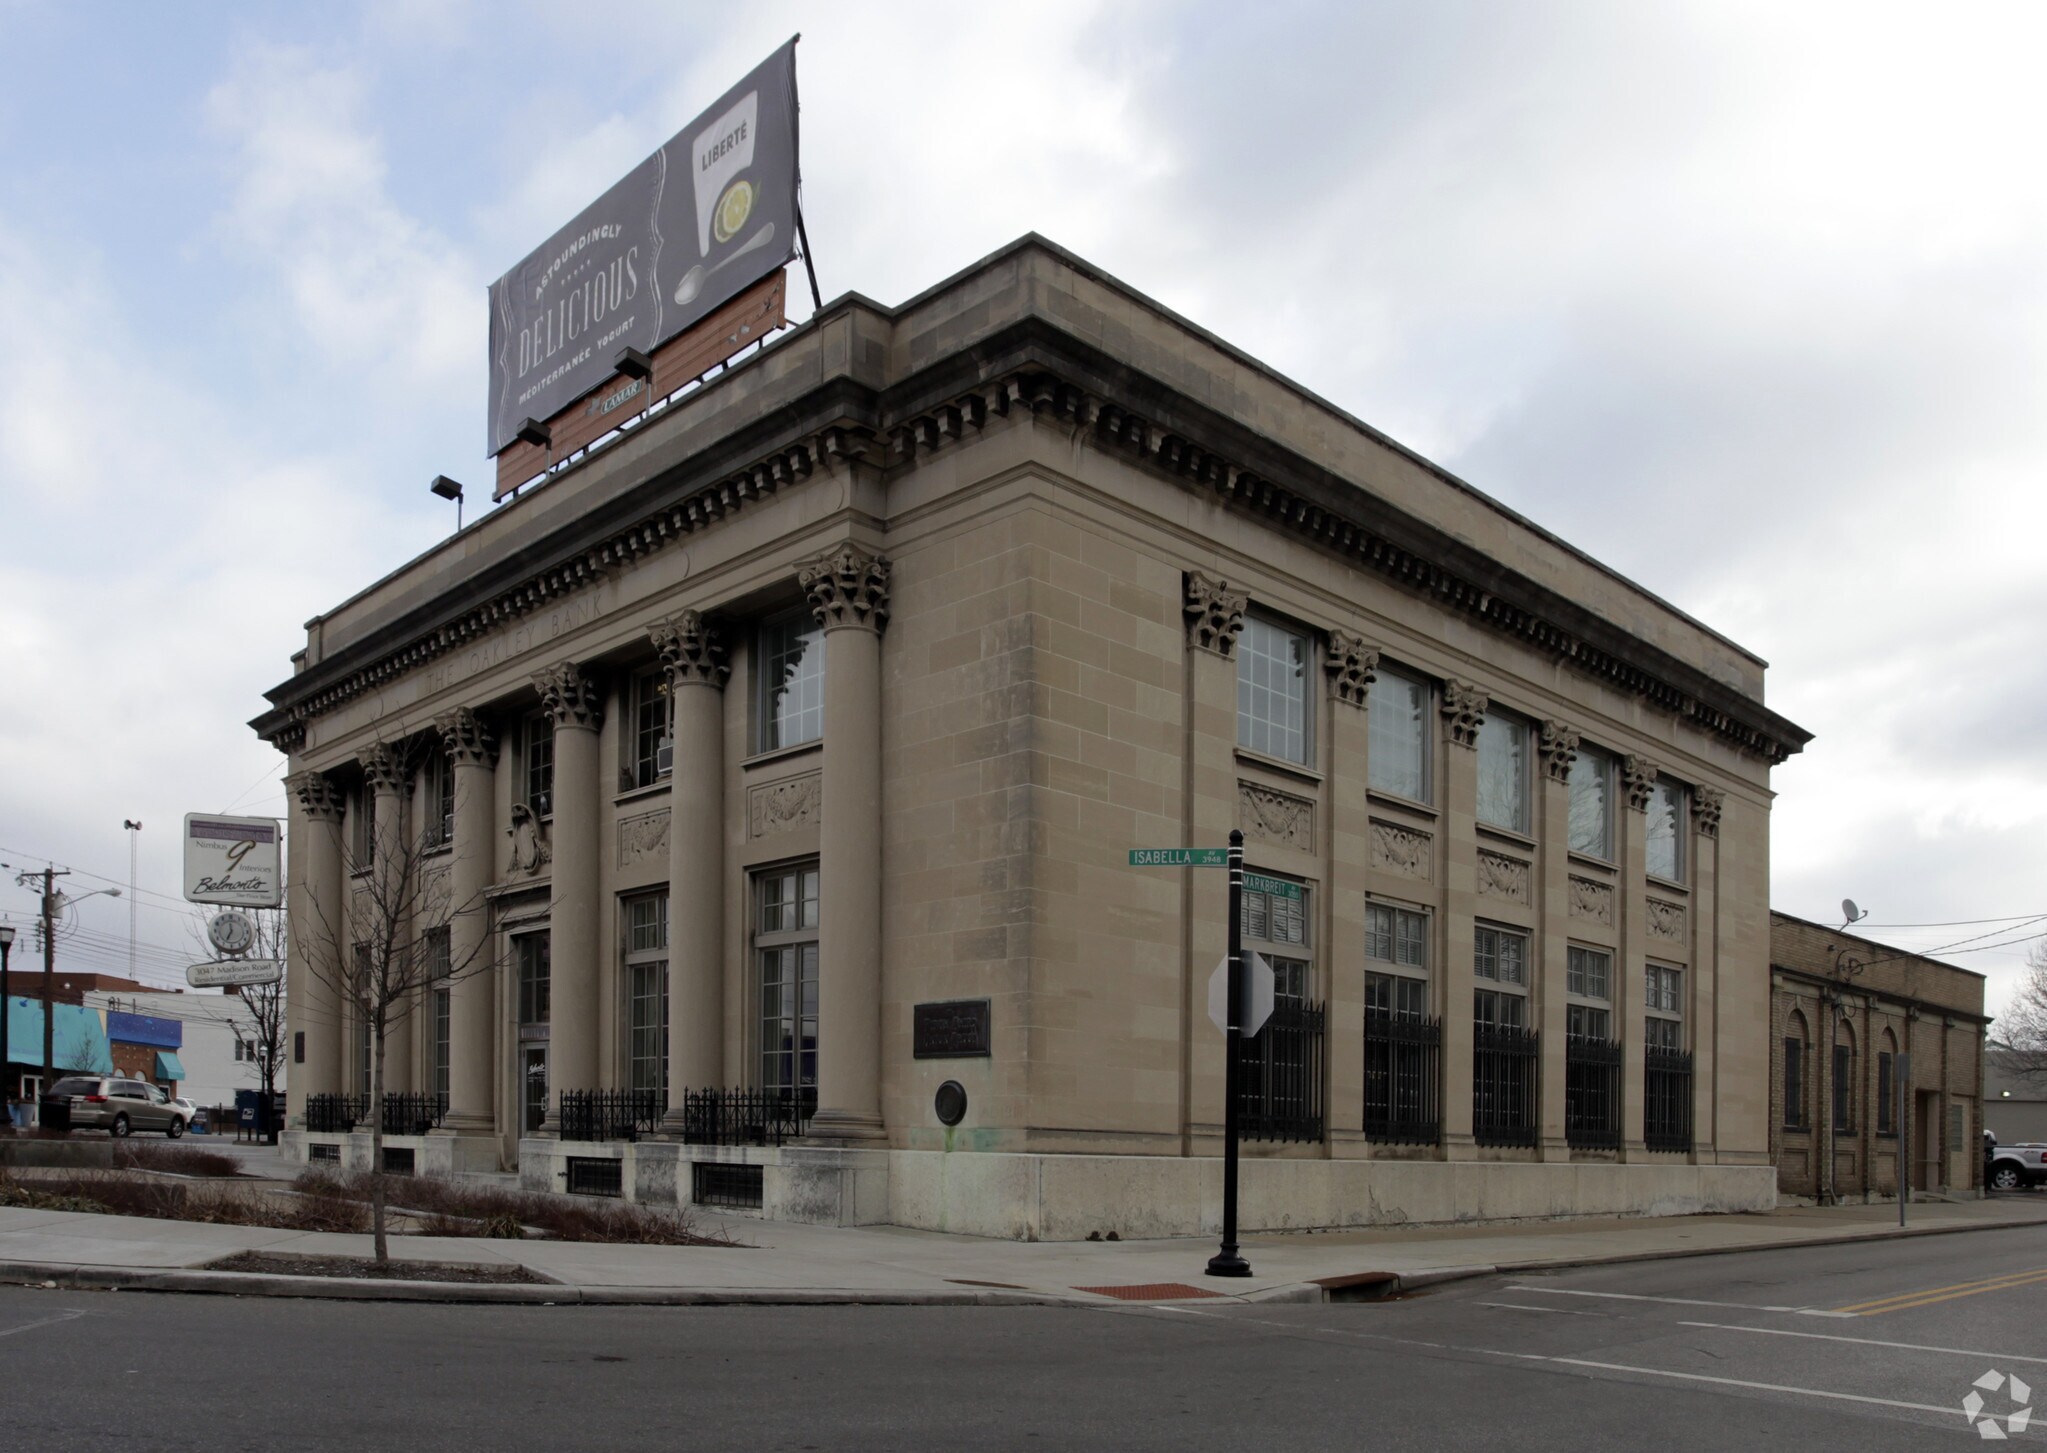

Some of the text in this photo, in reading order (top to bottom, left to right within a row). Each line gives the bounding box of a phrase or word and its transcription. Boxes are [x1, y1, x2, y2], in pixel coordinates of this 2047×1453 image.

[702, 119, 747, 172] LIBERTÉ
[536, 223, 622, 300] ASTOUNDINGLY
[518, 245, 638, 379] DELICIOUS
[597, 315, 635, 350] YOGURT
[604, 381, 639, 412] LAMAR
[427, 594, 602, 695] THE OAKLEY BANK
[195, 840, 228, 850] Nimbus
[1134, 850, 1191, 864] ISABELLA
[239, 863, 272, 873] Interiors
[1202, 855, 1222, 863] 3948
[1243, 875, 1286, 895] MARKBREIT
[217, 964, 250, 975] Madison
[251, 962, 272, 972] Road
